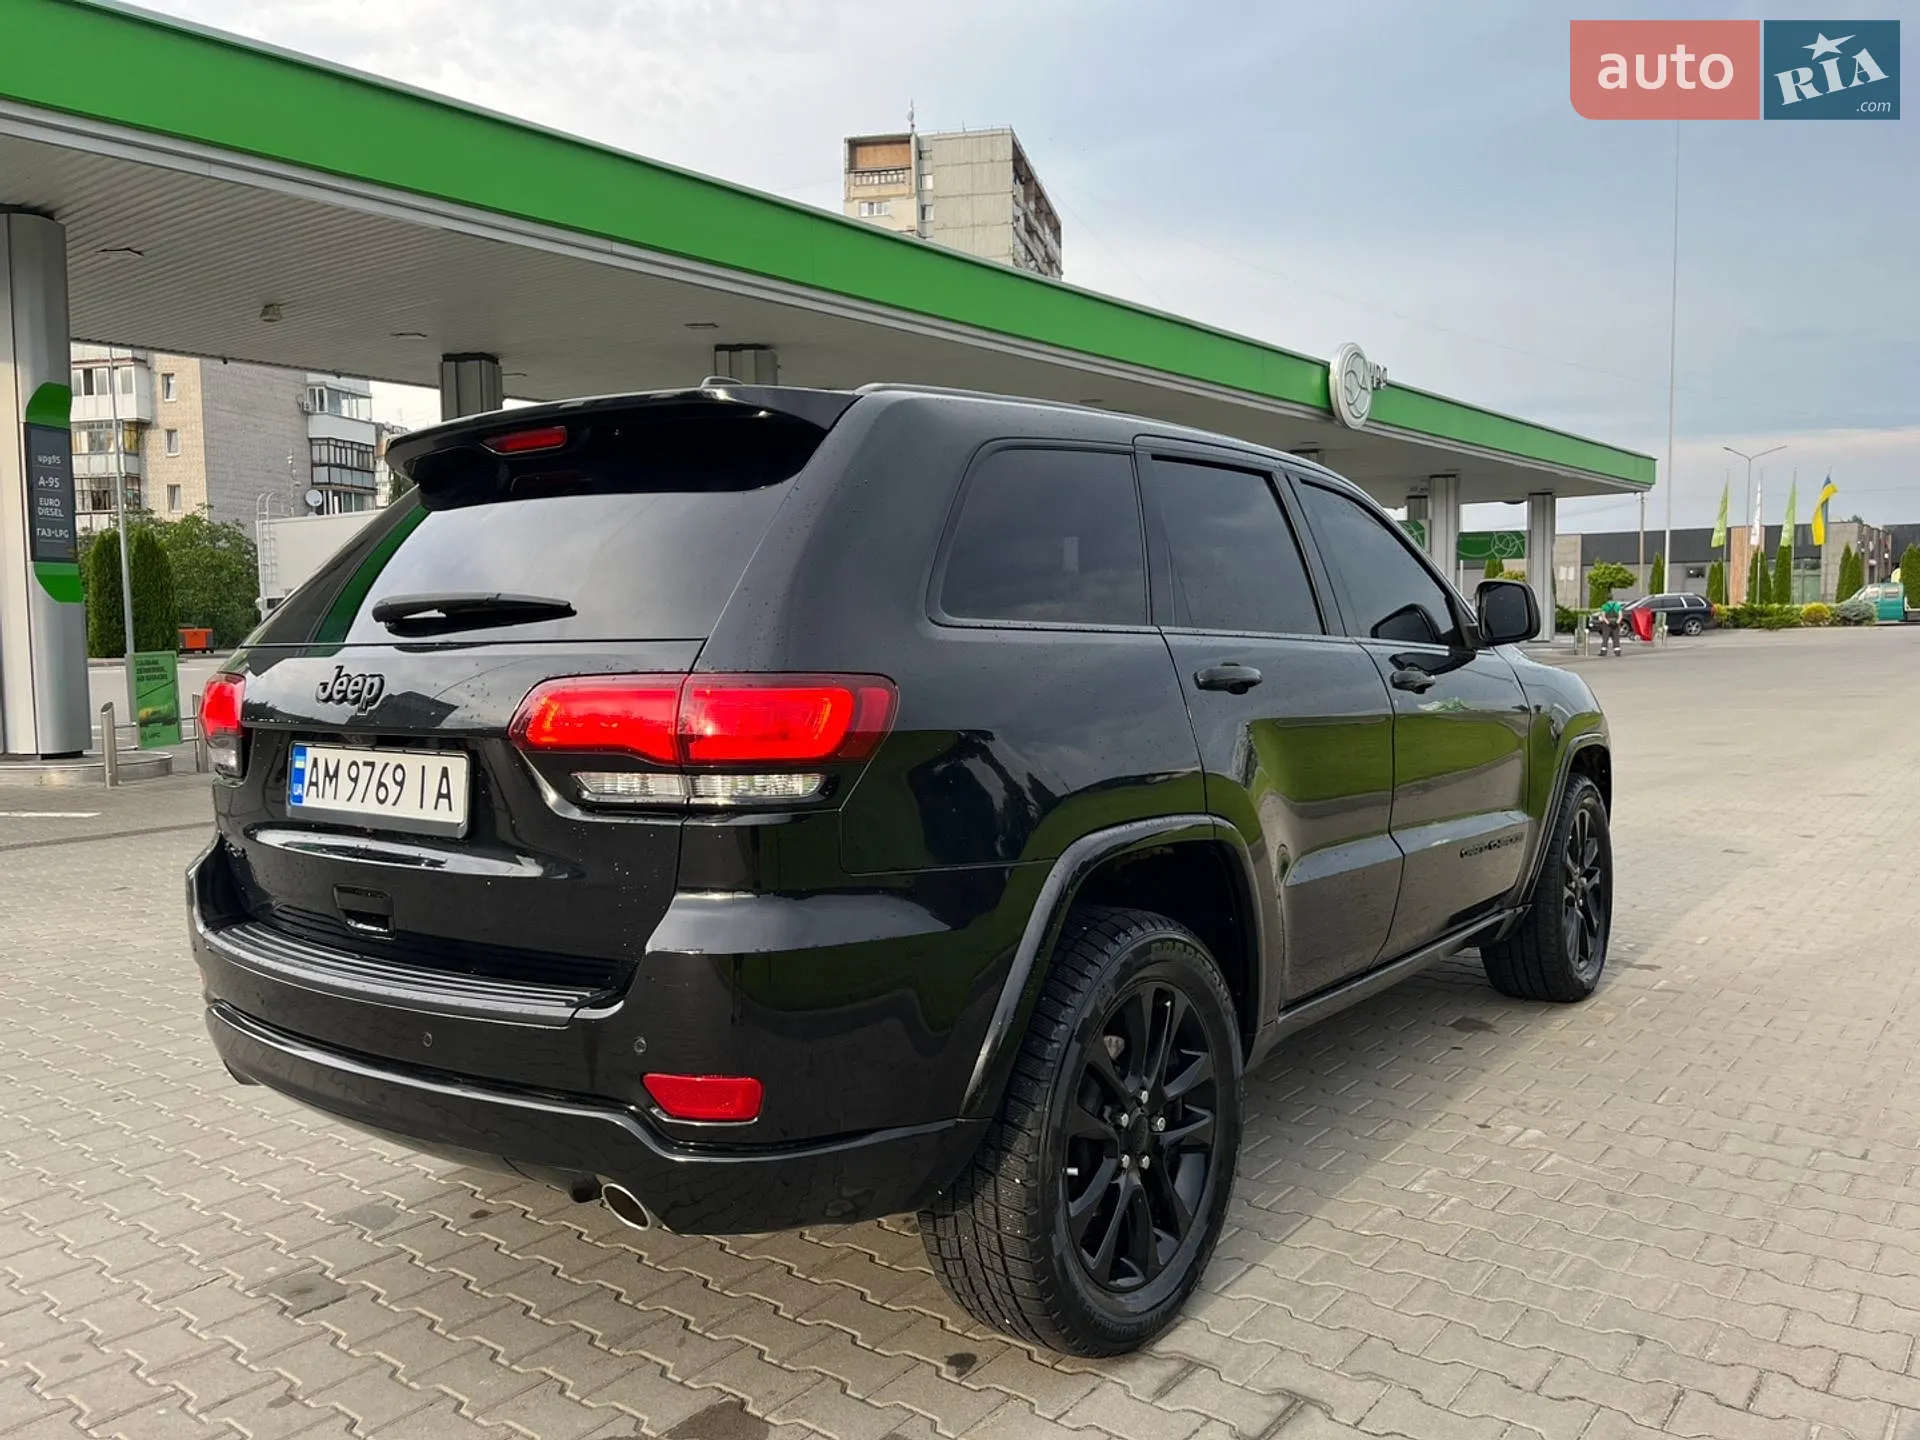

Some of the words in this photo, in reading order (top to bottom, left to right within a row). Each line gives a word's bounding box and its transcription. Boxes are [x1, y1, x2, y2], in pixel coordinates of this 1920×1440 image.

[38, 506, 64, 517] DIESEL
[39, 497, 61, 507] EURO
[316, 665, 385, 715] Jeep
[306, 757, 341, 800] AM
[346, 760, 406, 806] 9769
[419, 765, 452, 812] IA
